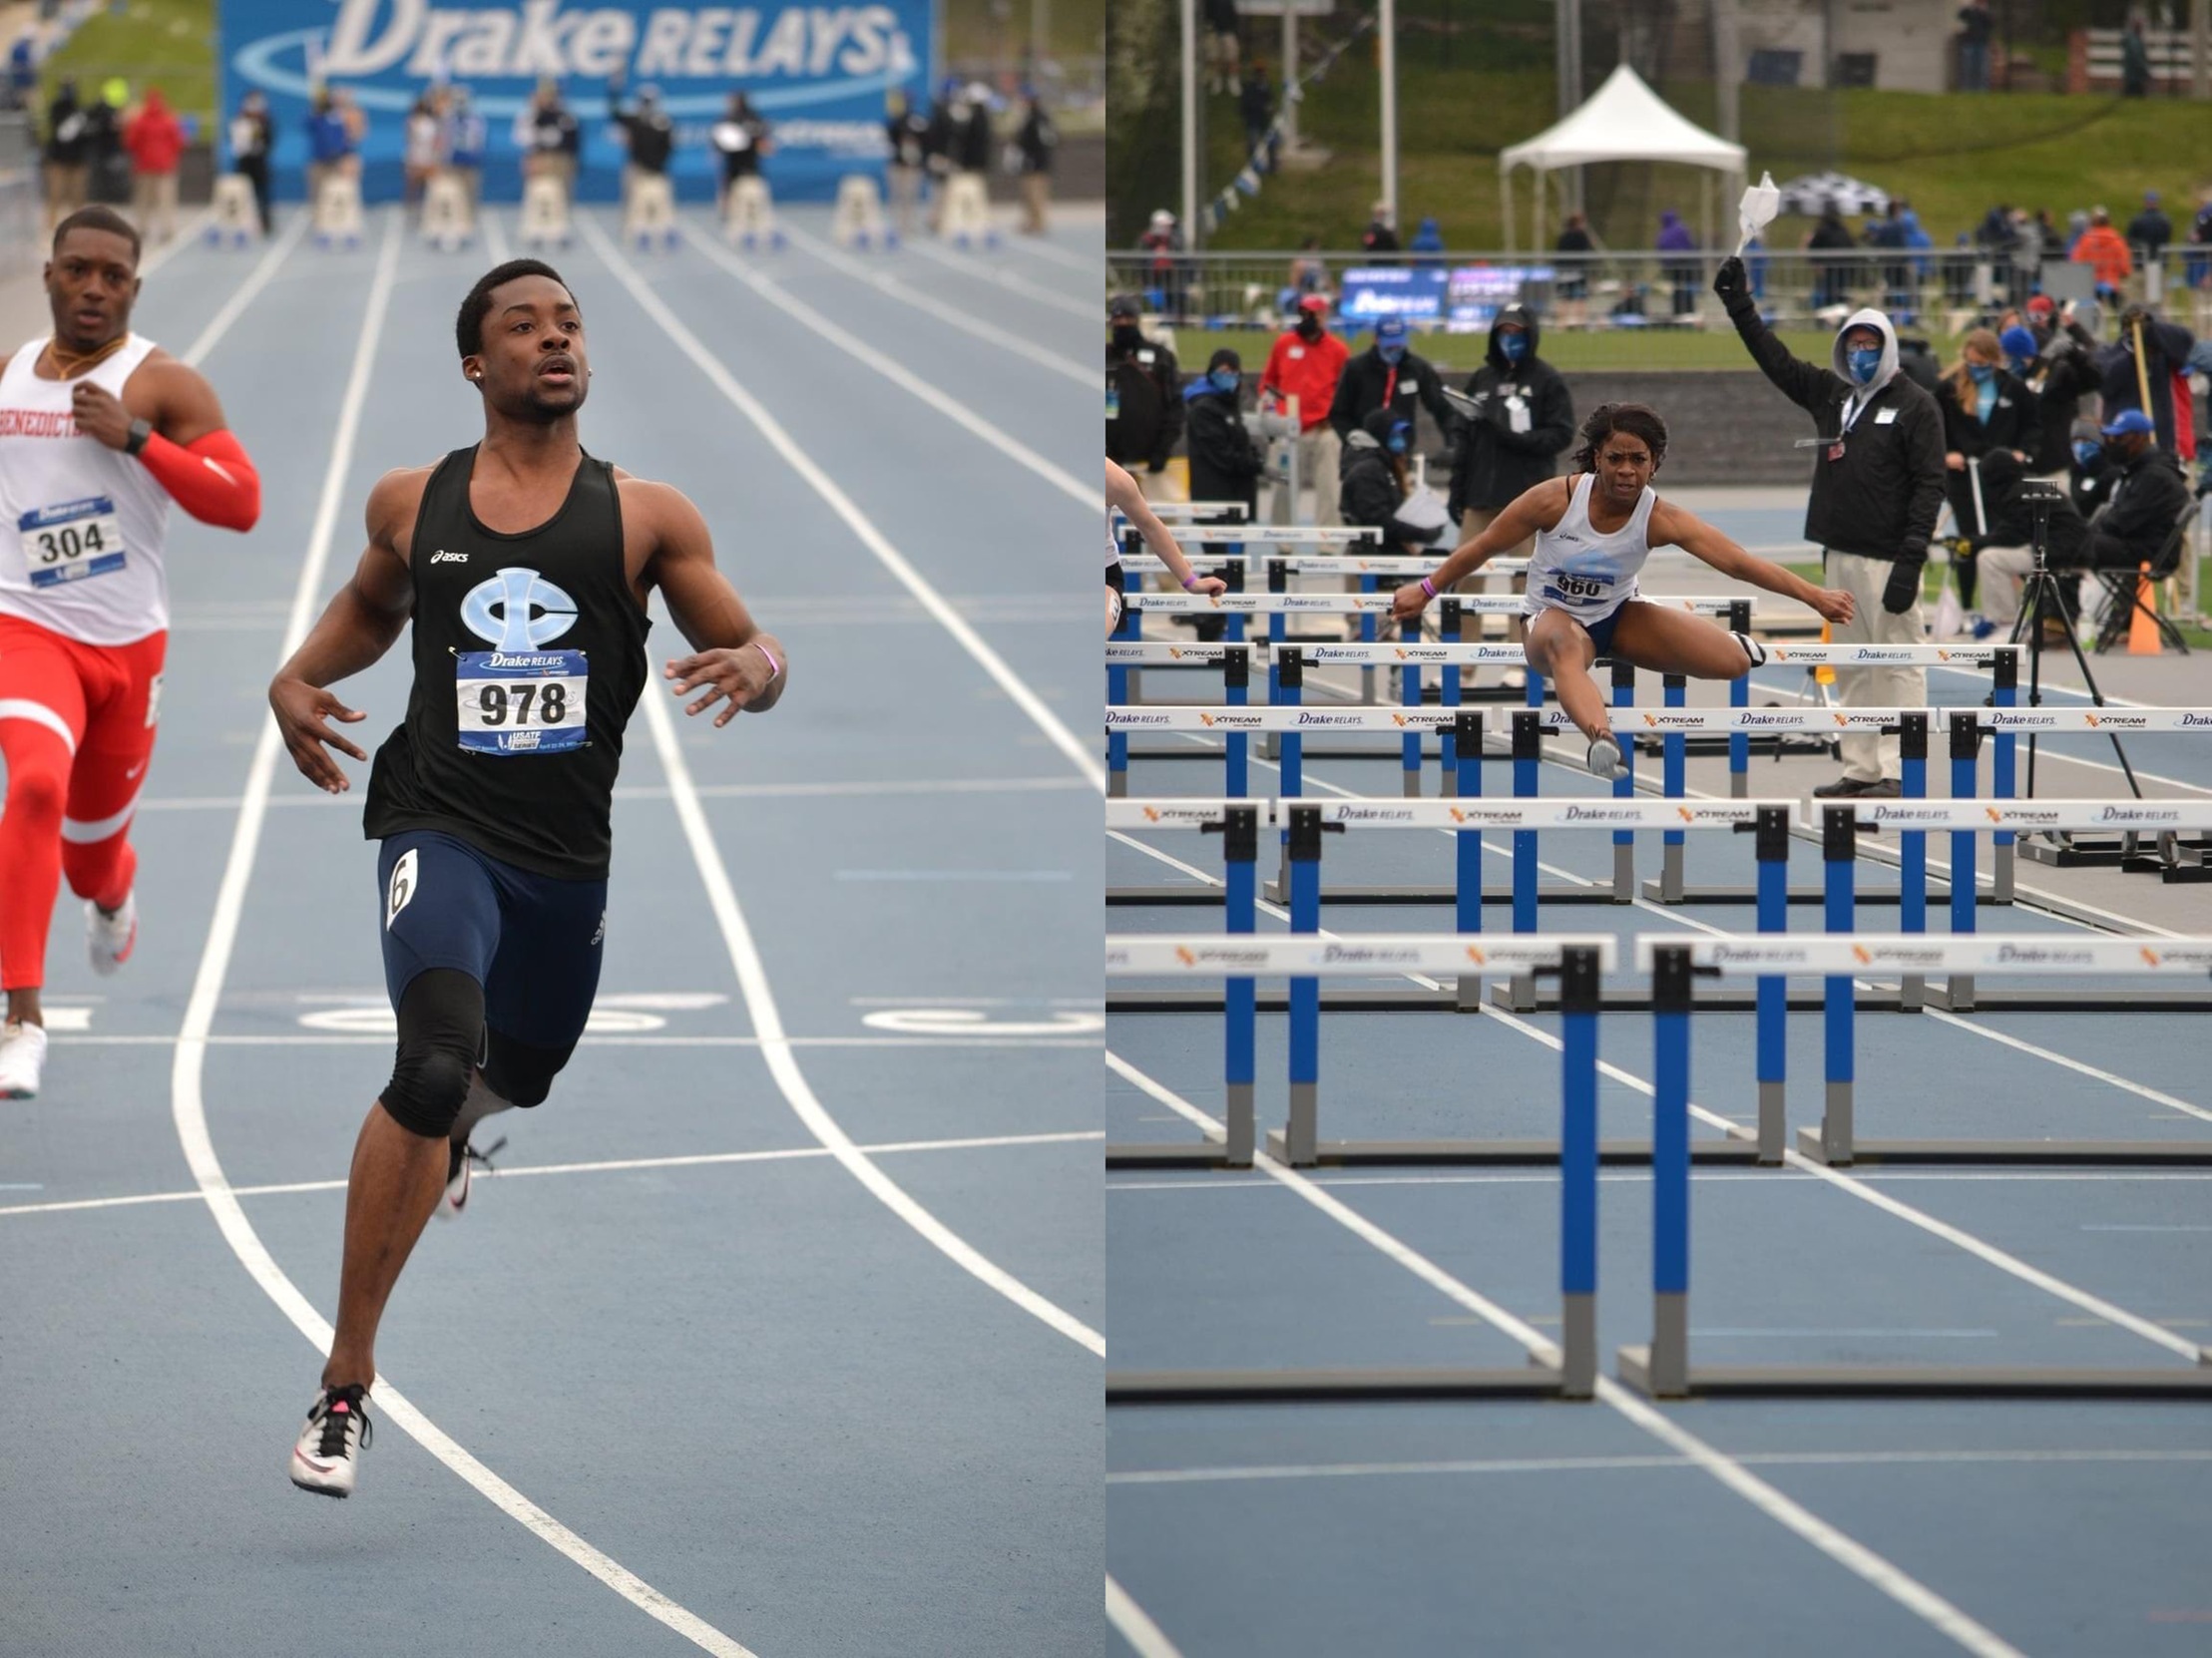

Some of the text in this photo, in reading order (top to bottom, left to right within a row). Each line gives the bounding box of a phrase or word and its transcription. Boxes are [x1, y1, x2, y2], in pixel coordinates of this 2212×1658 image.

[323, 0, 638, 77] Drake
[0, 409, 86, 437] BENEDICT
[39, 523, 105, 564] 304
[1556, 576, 1600, 597] 960
[490, 652, 564, 667] Drake RELAYS
[1315, 647, 1345, 658] Drake
[1478, 647, 1507, 658] Drake
[1858, 648, 1887, 659] Drake
[480, 683, 566, 725] 978
[1106, 711, 1140, 723] Drake
[1298, 712, 1333, 724] Drake
[1549, 711, 1574, 723] Dra
[1740, 712, 1776, 724] Drake
[1991, 712, 2026, 725] Drake
[1337, 805, 1378, 820] Drake
[1566, 806, 1606, 820] Drake
[1874, 806, 1915, 820] Drake
[2002, 811, 2058, 820] XTREAM
[2102, 806, 2143, 821] Drake
[392, 859, 408, 915] 6
